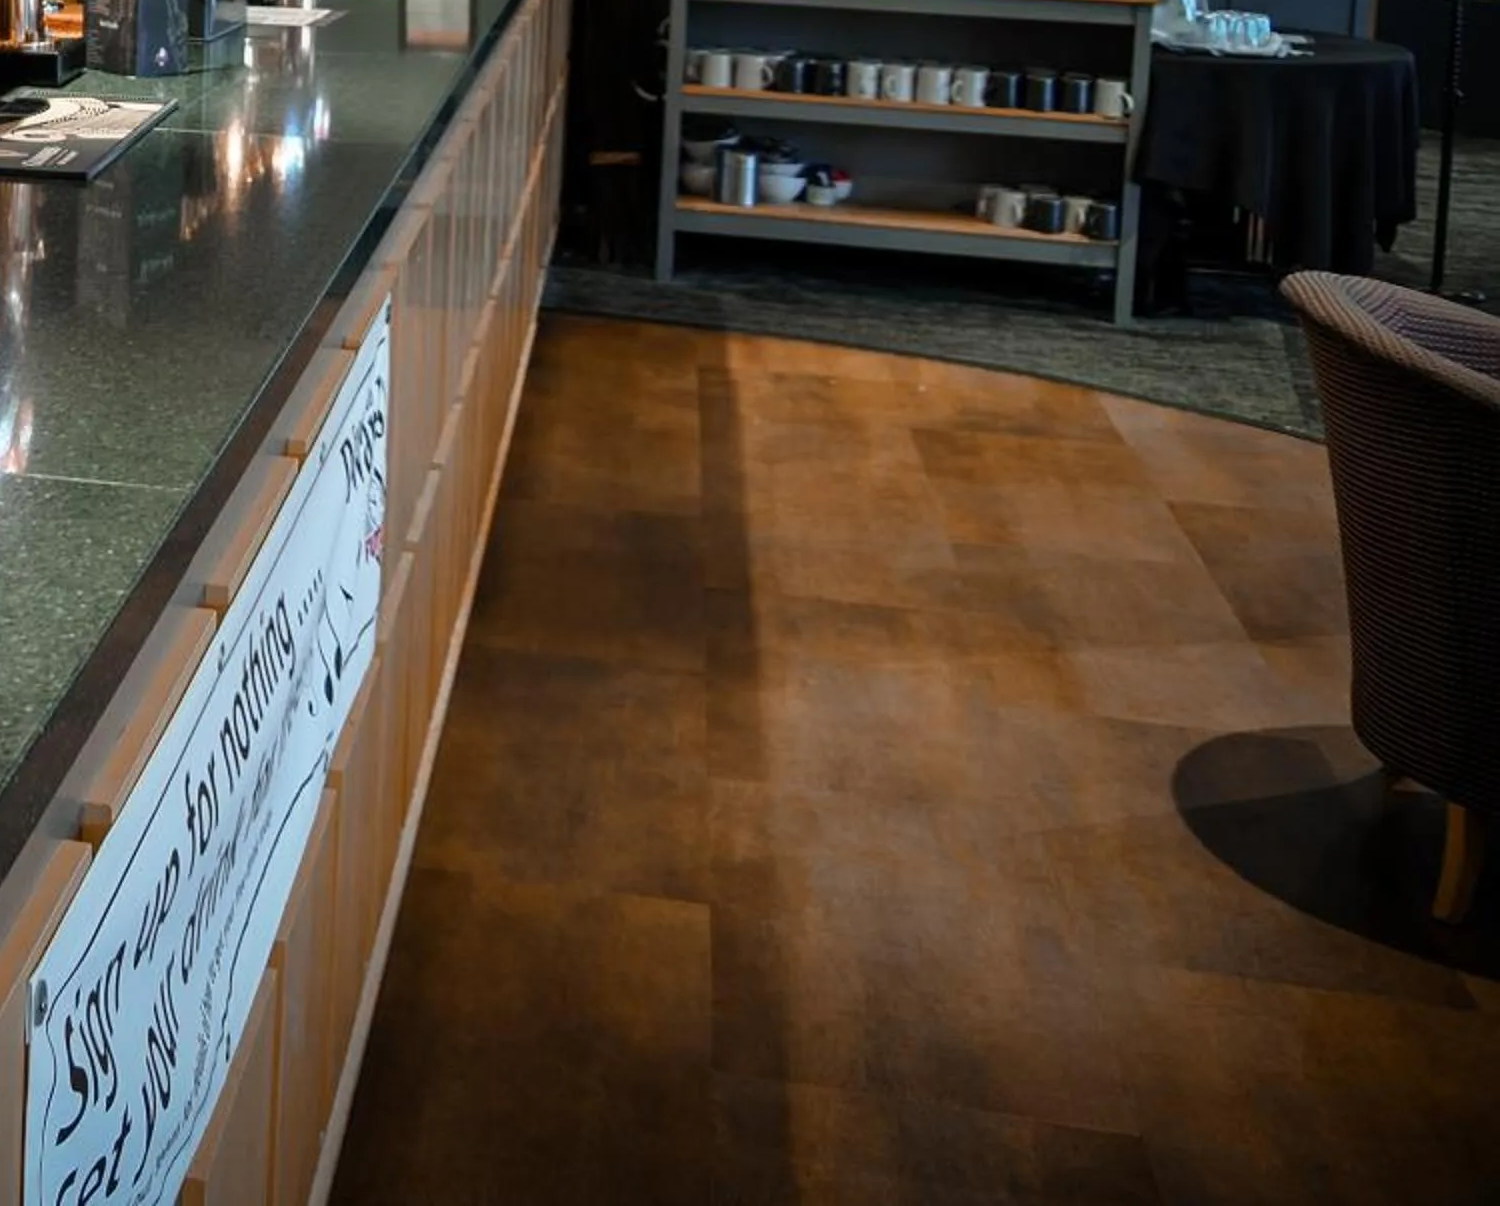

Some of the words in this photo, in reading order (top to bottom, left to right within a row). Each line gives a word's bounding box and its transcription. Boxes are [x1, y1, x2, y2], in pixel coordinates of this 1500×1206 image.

[55, 939, 127, 1147] Sign
[133, 847, 180, 971] up
[185, 750, 220, 880] for
[219, 590, 298, 796] nothing
[131, 950, 180, 1189] your
